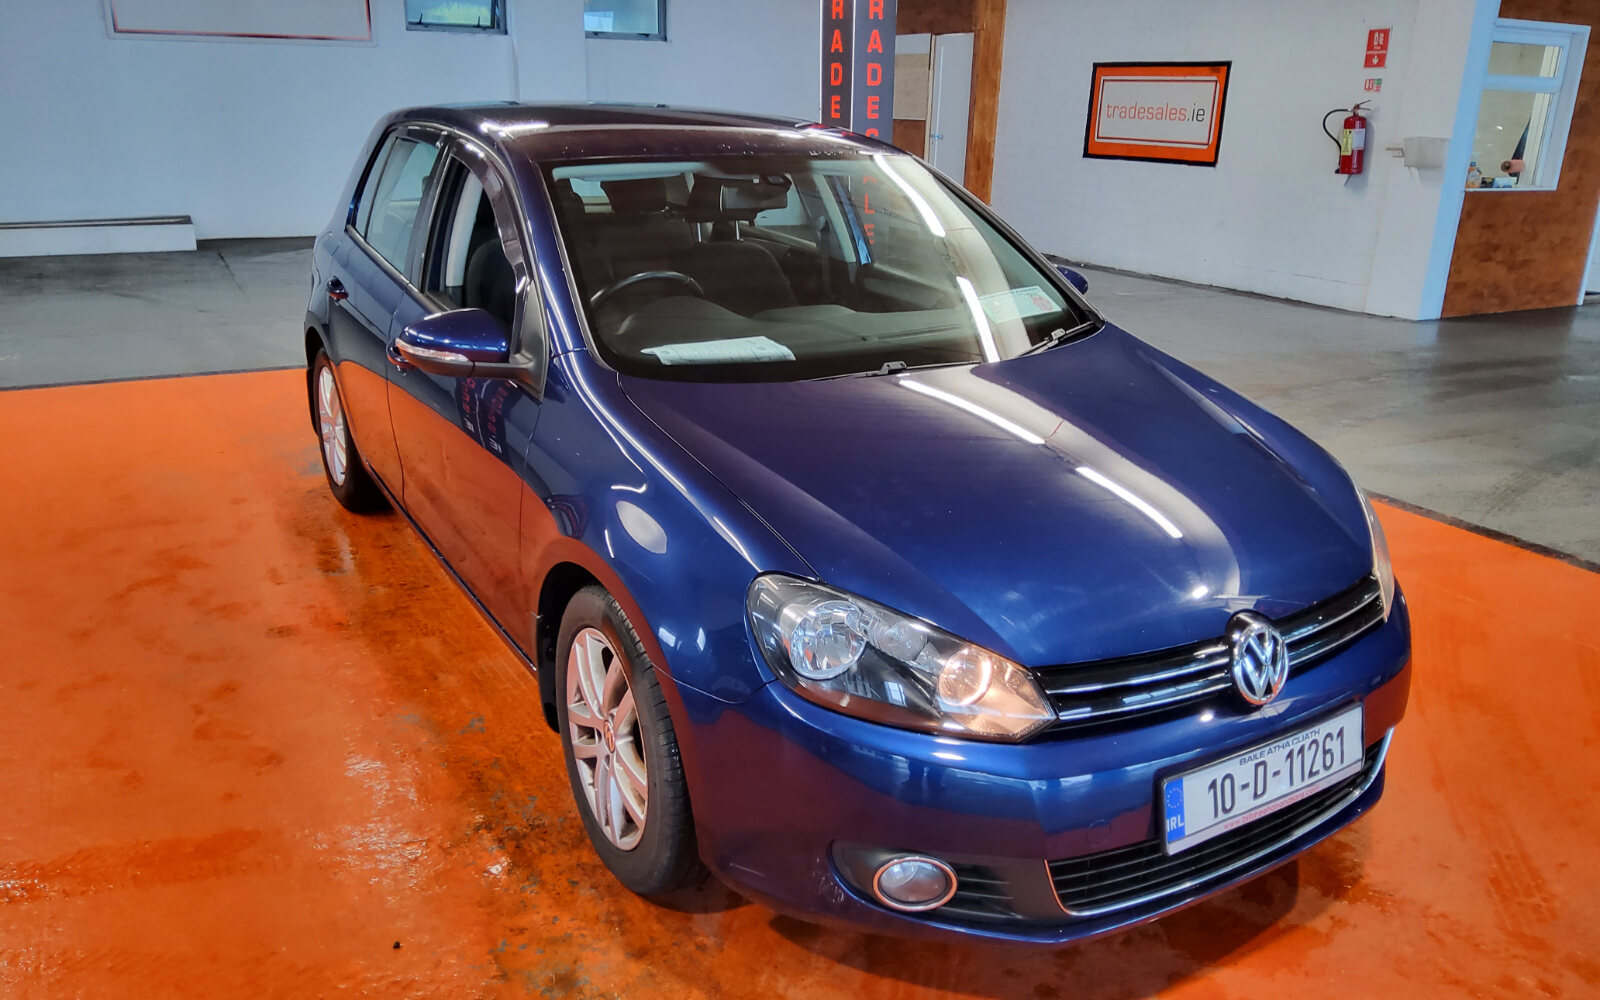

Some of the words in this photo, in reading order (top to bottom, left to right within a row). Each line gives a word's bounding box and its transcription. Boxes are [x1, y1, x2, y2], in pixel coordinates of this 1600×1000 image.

[1106, 101, 1206, 122] tradesales.ie
[1239, 750, 1266, 766] BAILE
[1291, 728, 1321, 746] CLIATH
[1207, 726, 1345, 819] 10-D-11261
[1166, 811, 1185, 833] IRL
